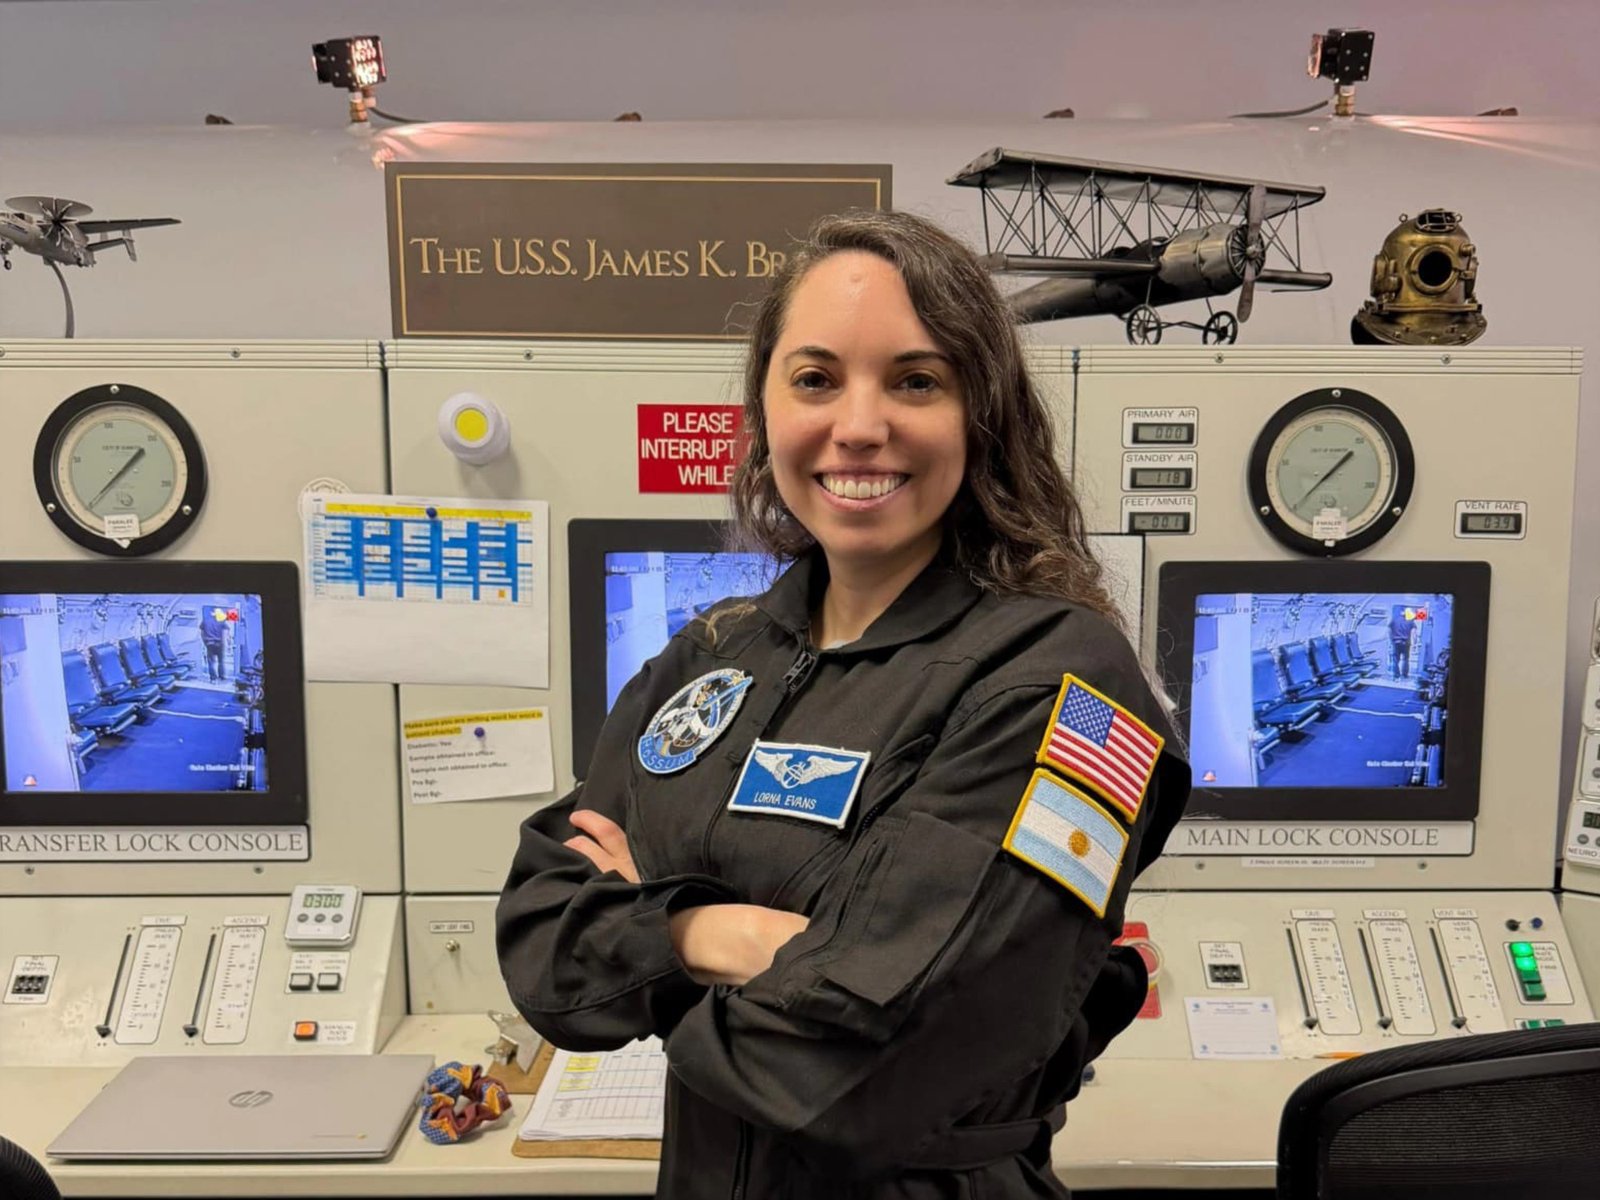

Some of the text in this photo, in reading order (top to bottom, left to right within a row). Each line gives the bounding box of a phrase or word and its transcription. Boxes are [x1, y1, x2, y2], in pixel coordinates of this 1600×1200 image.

[492, 237, 579, 276] U.S.S.
[698, 239, 736, 278] K.
[746, 240, 787, 279] BR
[663, 411, 734, 433] PLEASE
[1127, 409, 1196, 418] PRIMARY AIR
[640, 438, 736, 460] INTERRUPT
[1126, 453, 1195, 462] STANDBY AIR
[678, 465, 736, 486] WHILE
[1124, 497, 1194, 507] FEET/MINUTE
[1464, 501, 1521, 511] VENT RATE
[1484, 516, 1511, 529] 039
[753, 791, 817, 810] LORNA EVANS
[0, 833, 304, 852] RANSFER LOCK CONSOLE
[1187, 828, 1440, 847] MAIN LOCK CONSOLE
[1568, 847, 1598, 857] NEURO
